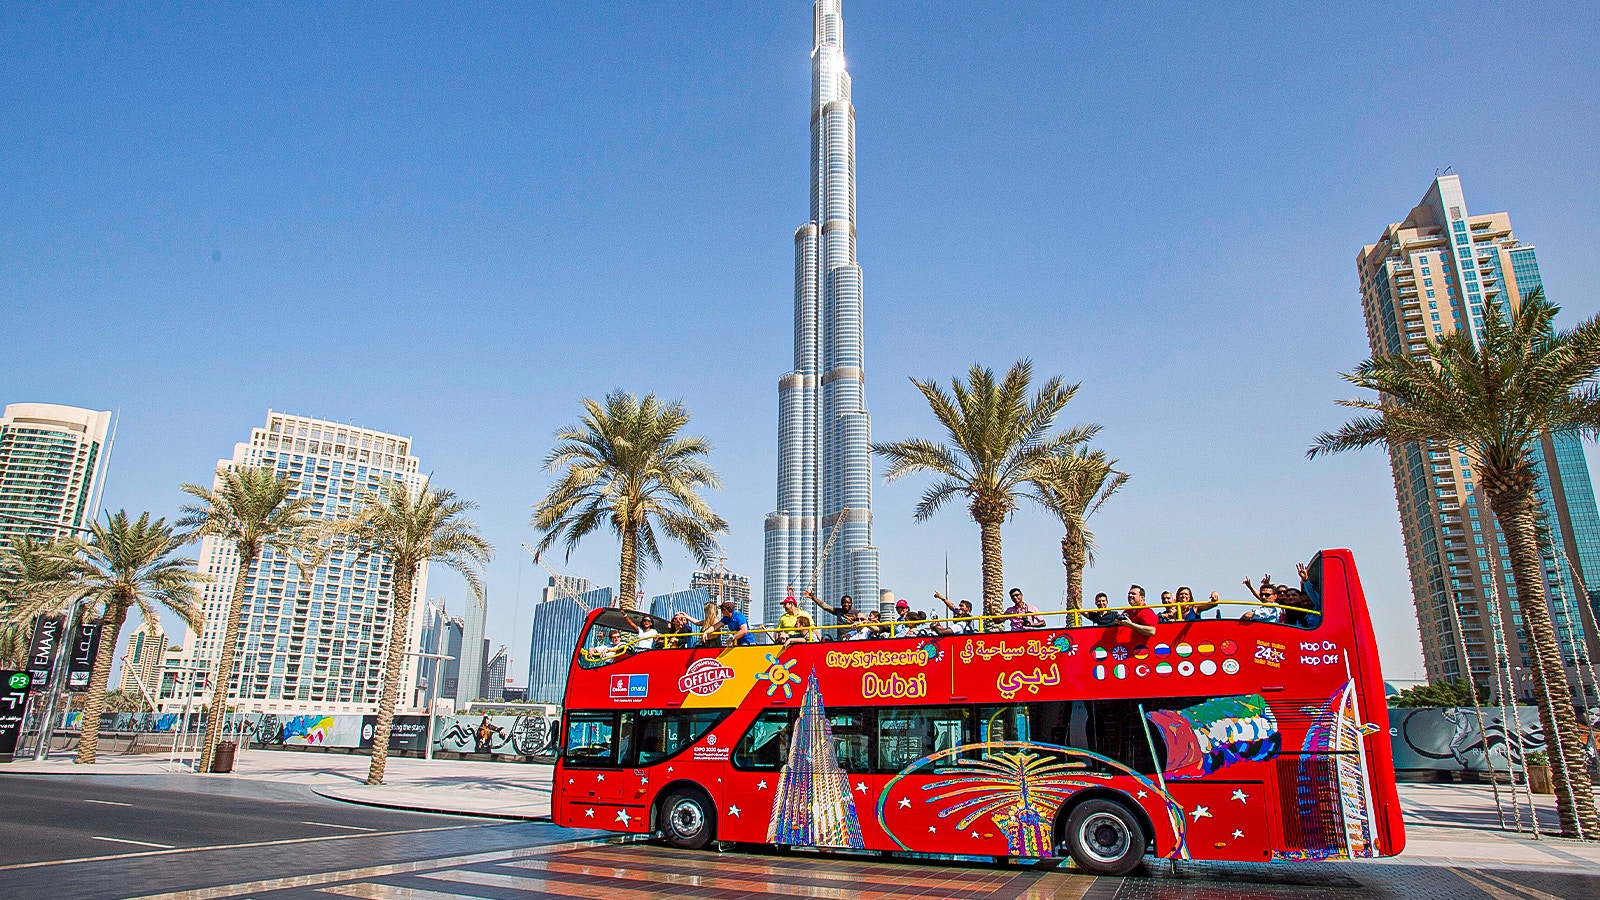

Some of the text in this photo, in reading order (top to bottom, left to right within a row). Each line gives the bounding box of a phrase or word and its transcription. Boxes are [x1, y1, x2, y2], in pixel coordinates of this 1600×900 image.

[34, 620, 58, 665] EMAAR
[960, 639, 1060, 664] جولة سياحية في
[1299, 640, 1337, 652] Hop On
[1300, 654, 1339, 665] Hop Off
[9, 676, 27, 687] P3
[684, 669, 732, 688] OFFICIAL
[698, 682, 720, 694] TOUR
[862, 672, 927, 698] Dubai
[997, 663, 1061, 699] دبي
